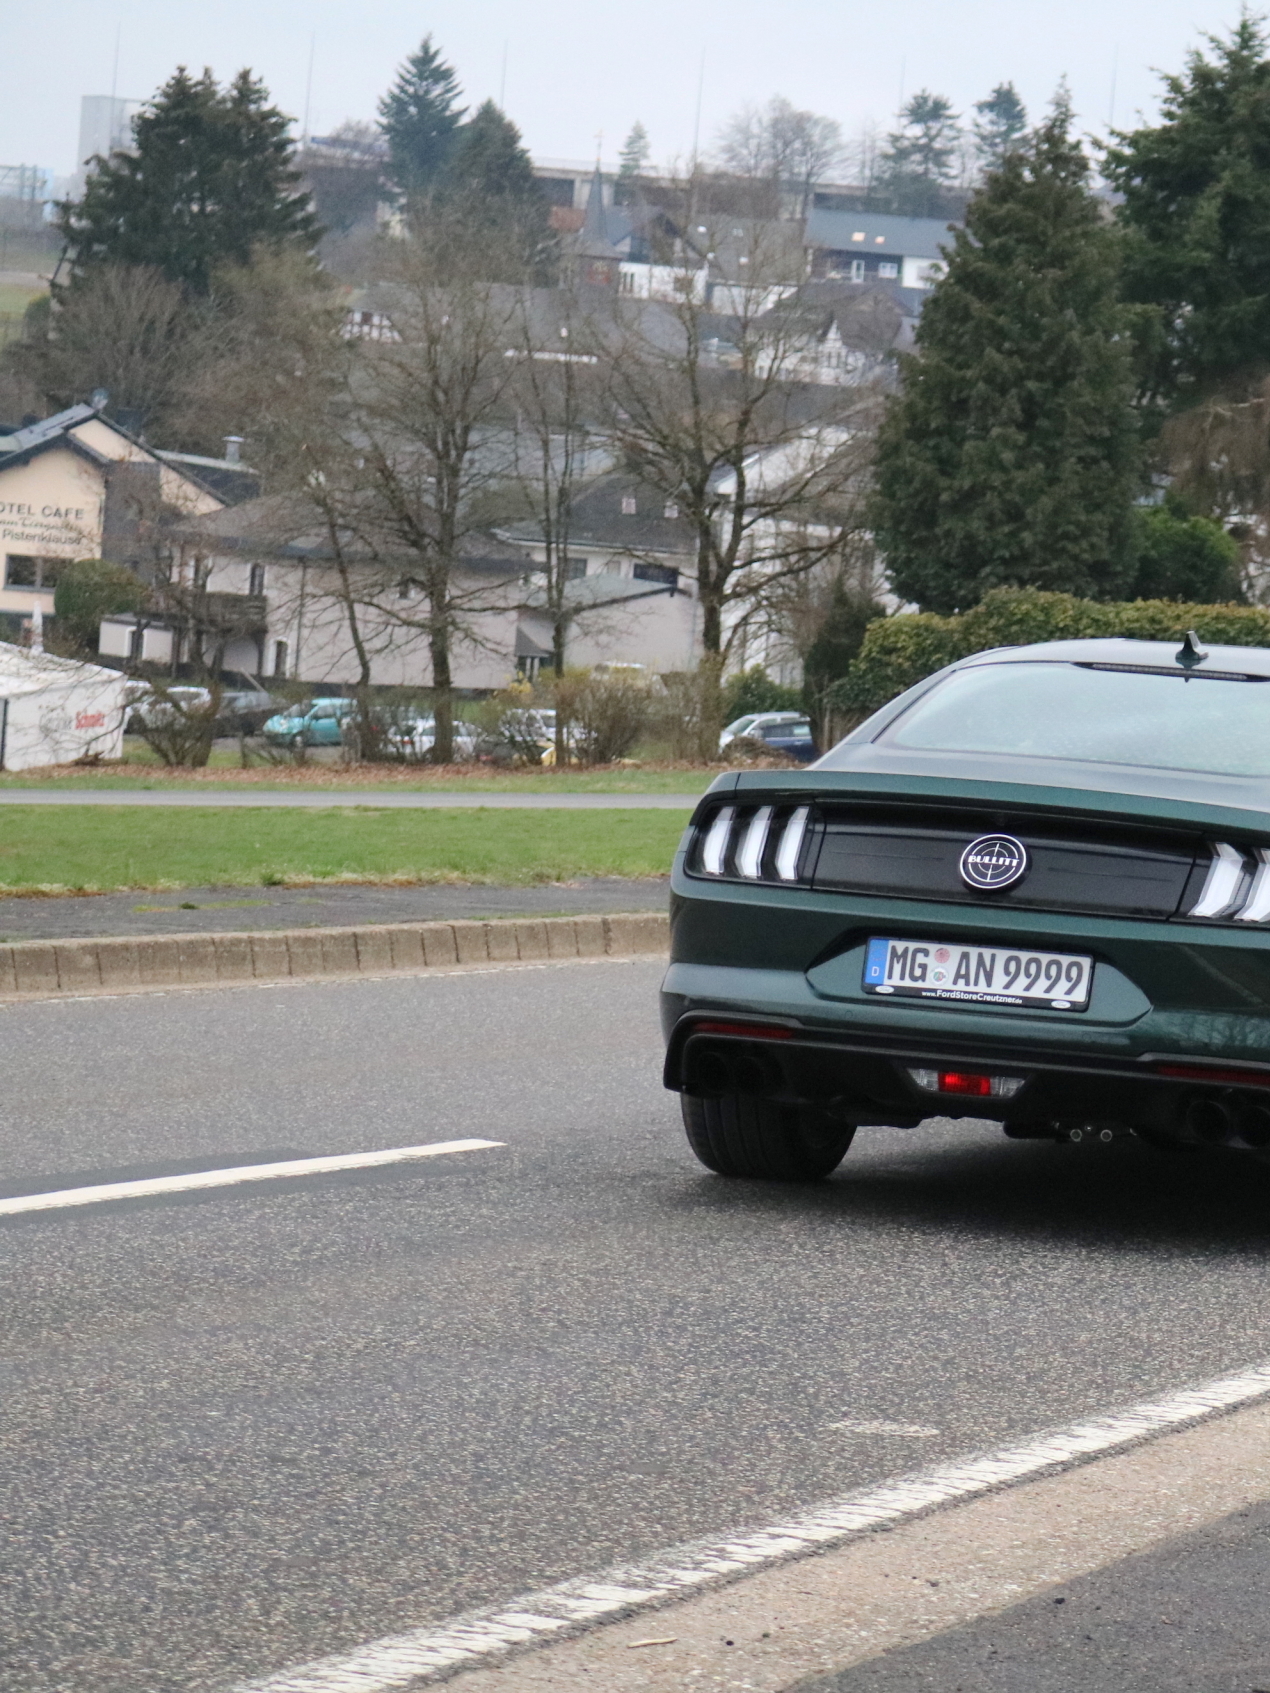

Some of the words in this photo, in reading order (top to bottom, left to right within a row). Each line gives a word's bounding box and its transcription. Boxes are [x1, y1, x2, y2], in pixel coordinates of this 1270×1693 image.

[41, 505, 84, 520] CAFE
[967, 855, 1020, 867] BULLITT
[871, 966, 880, 977] D
[887, 945, 930, 983] MG
[952, 951, 996, 988] AN
[1002, 954, 1084, 996] 9999
[921, 989, 1023, 1004] www.FordStoreCreutzner.de
